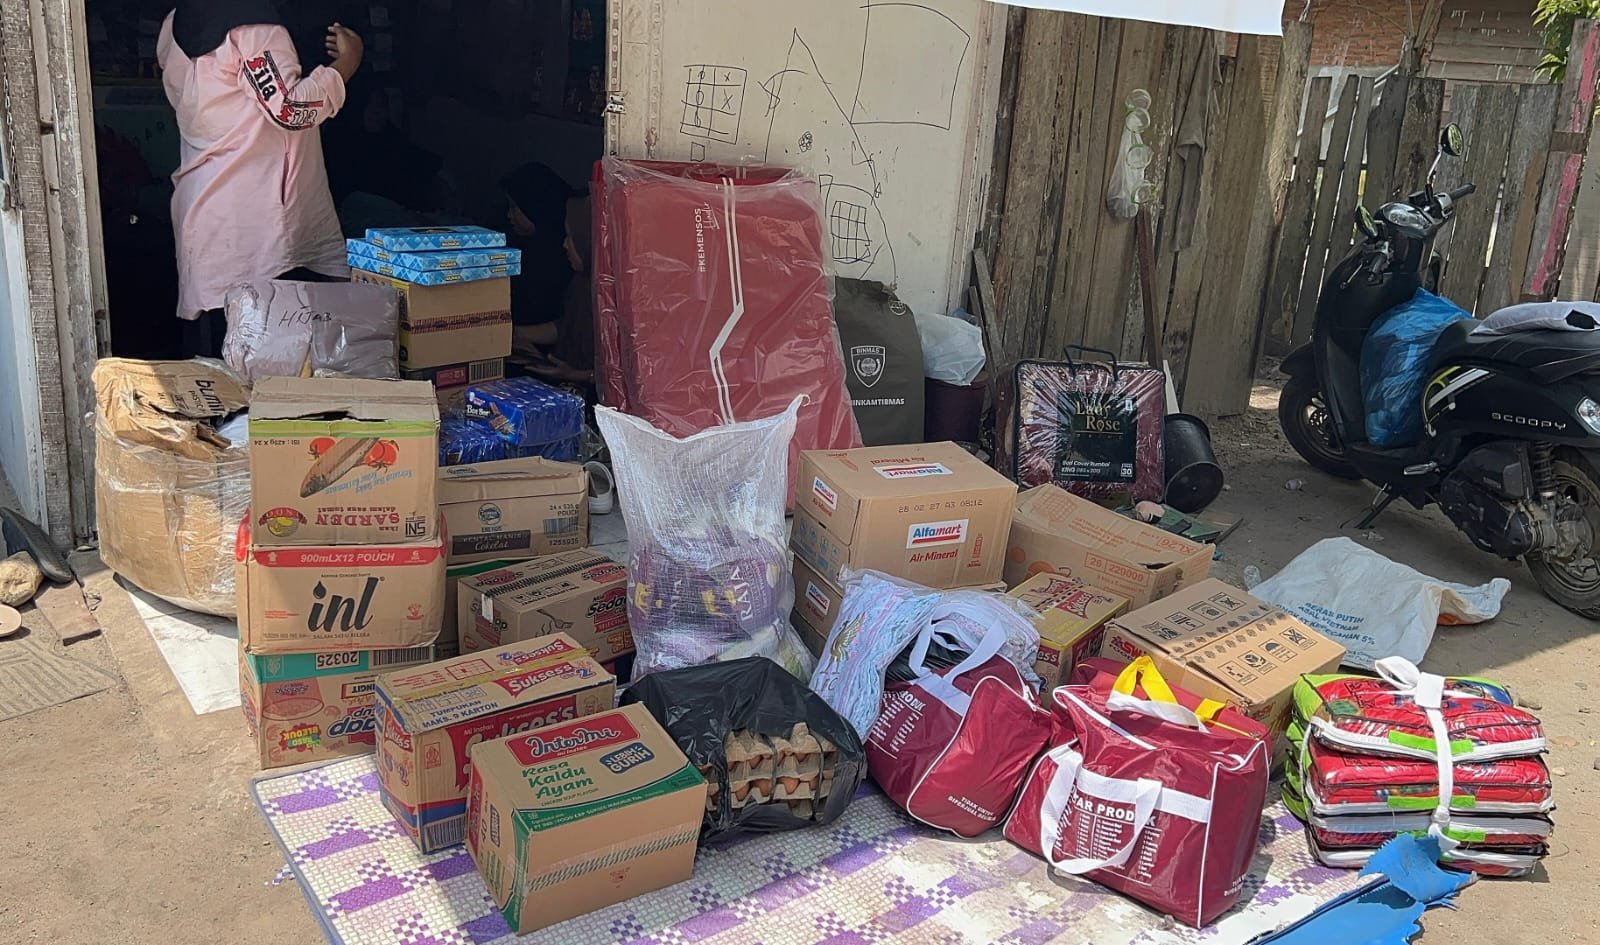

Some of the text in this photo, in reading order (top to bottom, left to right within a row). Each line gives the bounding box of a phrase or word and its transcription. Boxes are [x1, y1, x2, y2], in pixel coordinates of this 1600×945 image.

[1086, 415, 1121, 431] Rose
[1491, 412, 1566, 431] SCOOPY
[888, 466, 943, 477] Alfamart
[315, 512, 400, 527] SARDEN
[405, 520, 426, 538] SNI
[912, 523, 962, 539] Alfamart
[300, 552, 353, 563] 900mLX12
[356, 552, 395, 562] POUCH
[909, 549, 958, 563] Air Mineral
[307, 576, 379, 632] inl
[317, 651, 358, 667] 20325
[352, 683, 375, 694] INGIT
[430, 700, 482, 717] TUMPUKAN
[899, 690, 926, 711] RODUK
[461, 702, 498, 718] KARTON
[609, 747, 638, 764] LEBIH
[610, 749, 651, 773] GURIH
[522, 761, 569, 778] Rasa
[528, 767, 587, 788] Kaldu
[535, 777, 594, 799] Ayam
[1097, 803, 1157, 827] PRODK
